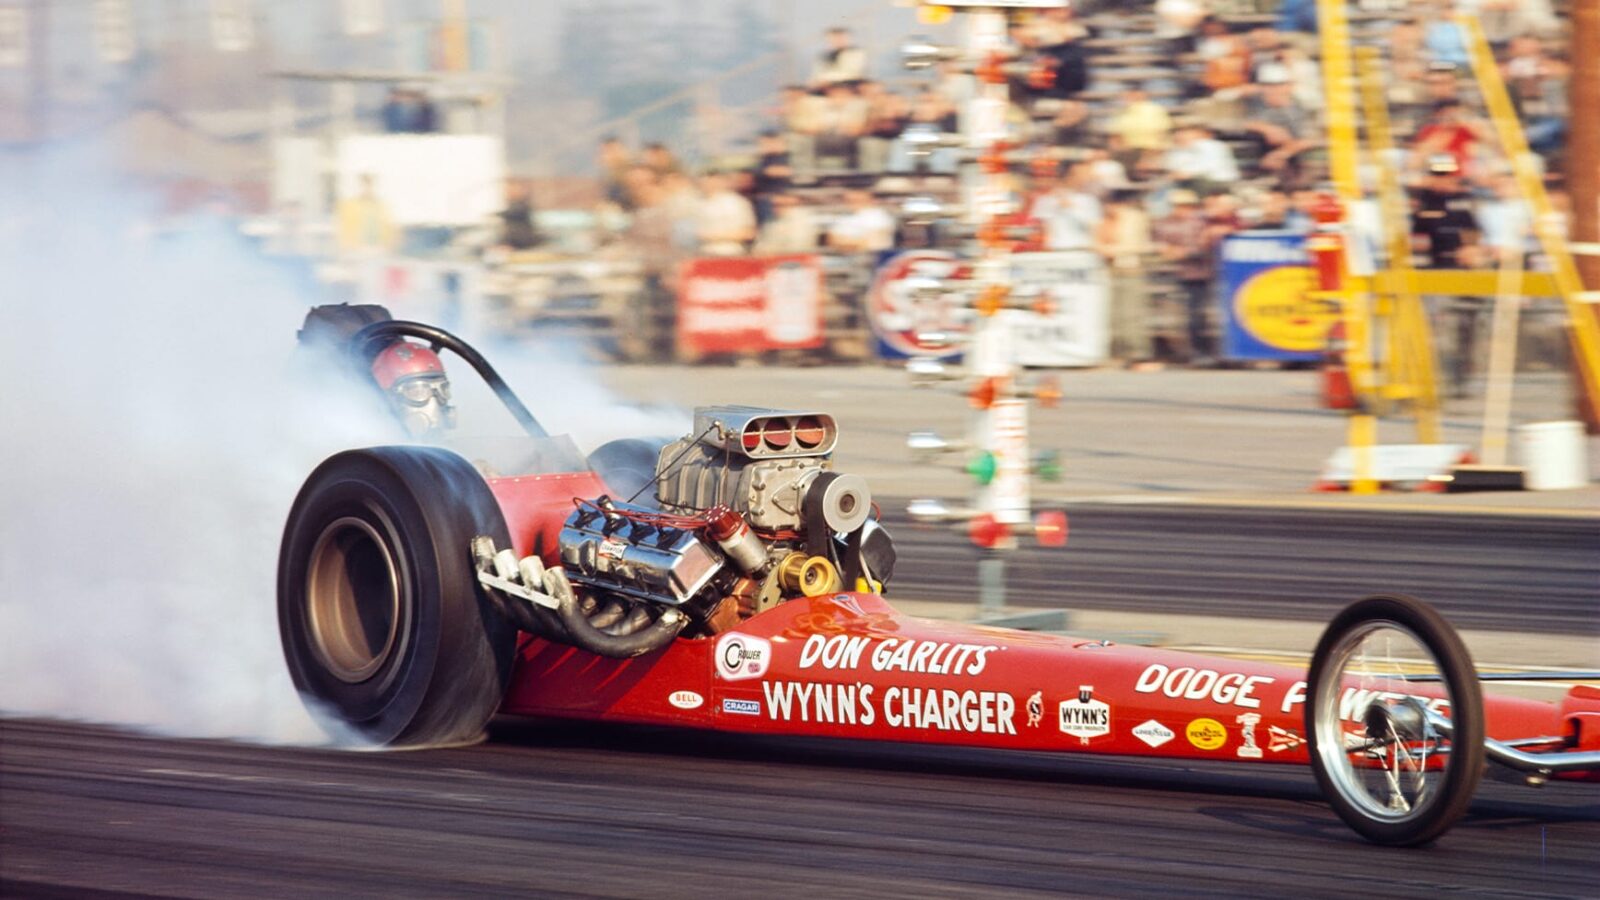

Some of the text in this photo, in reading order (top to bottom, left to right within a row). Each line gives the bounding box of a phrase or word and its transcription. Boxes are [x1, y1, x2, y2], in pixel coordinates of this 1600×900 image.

[799, 633, 871, 669] DON
[675, 693, 697, 702] BELL
[1135, 664, 1275, 709] DODGE
[725, 701, 759, 712] CRAGAR
[762, 680, 1018, 735] WYNN'S CHARGER
[1062, 707, 1107, 725] WYNN'S
